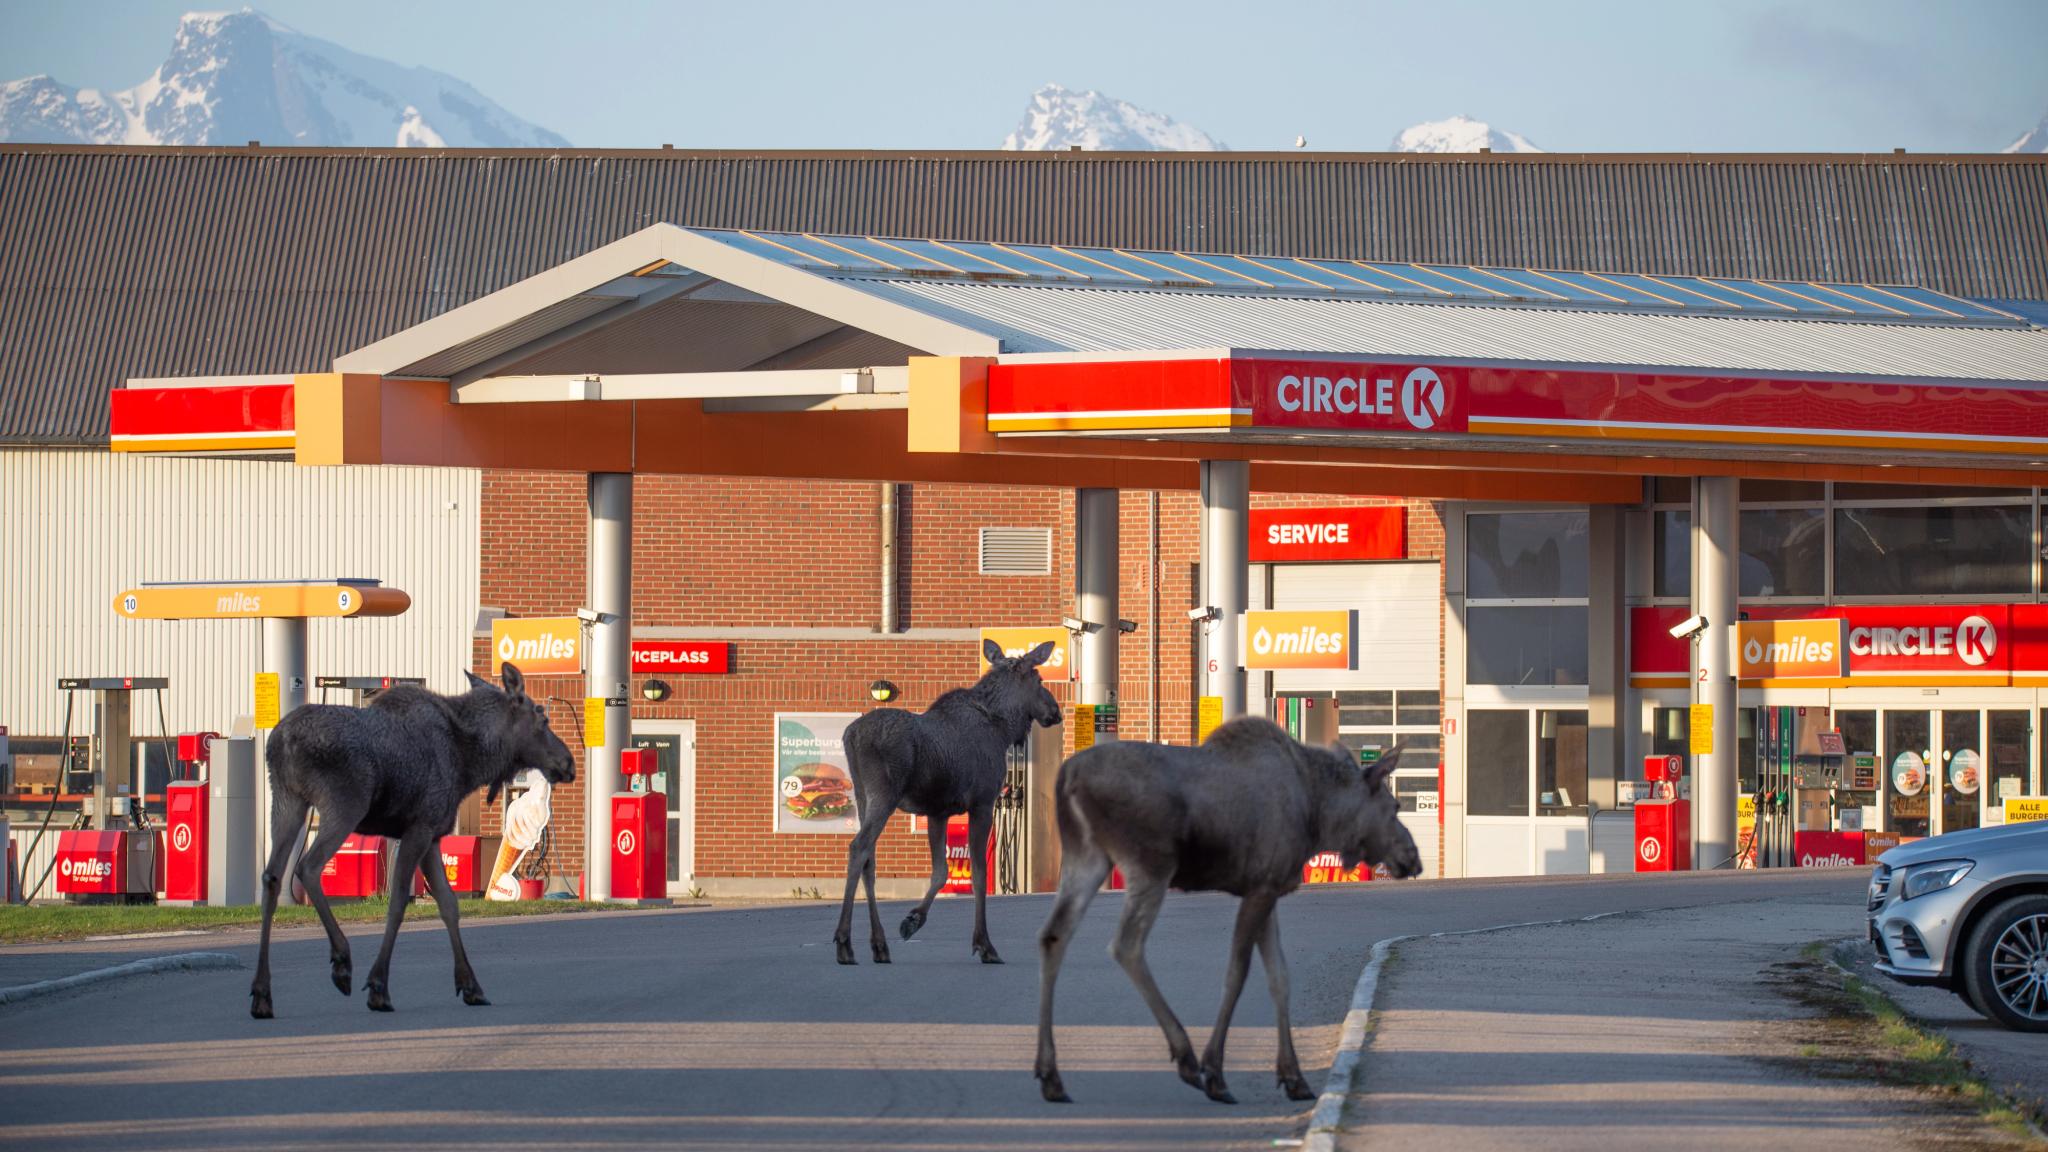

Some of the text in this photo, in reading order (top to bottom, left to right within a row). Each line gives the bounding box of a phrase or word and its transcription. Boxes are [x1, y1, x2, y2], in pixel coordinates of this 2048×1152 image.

[1277, 375, 1393, 415] CIRCLE
[1267, 523, 1349, 545] SERVICE
[125, 598, 136, 610] 10
[216, 592, 261, 613] miles
[341, 594, 348, 606] 9
[515, 632, 576, 660] miles
[1272, 626, 1343, 655] miles
[1849, 626, 1953, 657] CIRCLE
[1764, 635, 1834, 663] miles
[631, 651, 709, 664] ICEPLASS
[1208, 659, 1218, 673] 6
[1698, 668, 1708, 682] 2
[781, 736, 844, 749] Superburg
[783, 781, 798, 791] 79
[2019, 803, 2041, 811] ALLE
[1875, 835, 1896, 847] miles
[951, 844, 970, 859] mil
[72, 857, 112, 876] miles
[1814, 853, 1856, 867] miles
